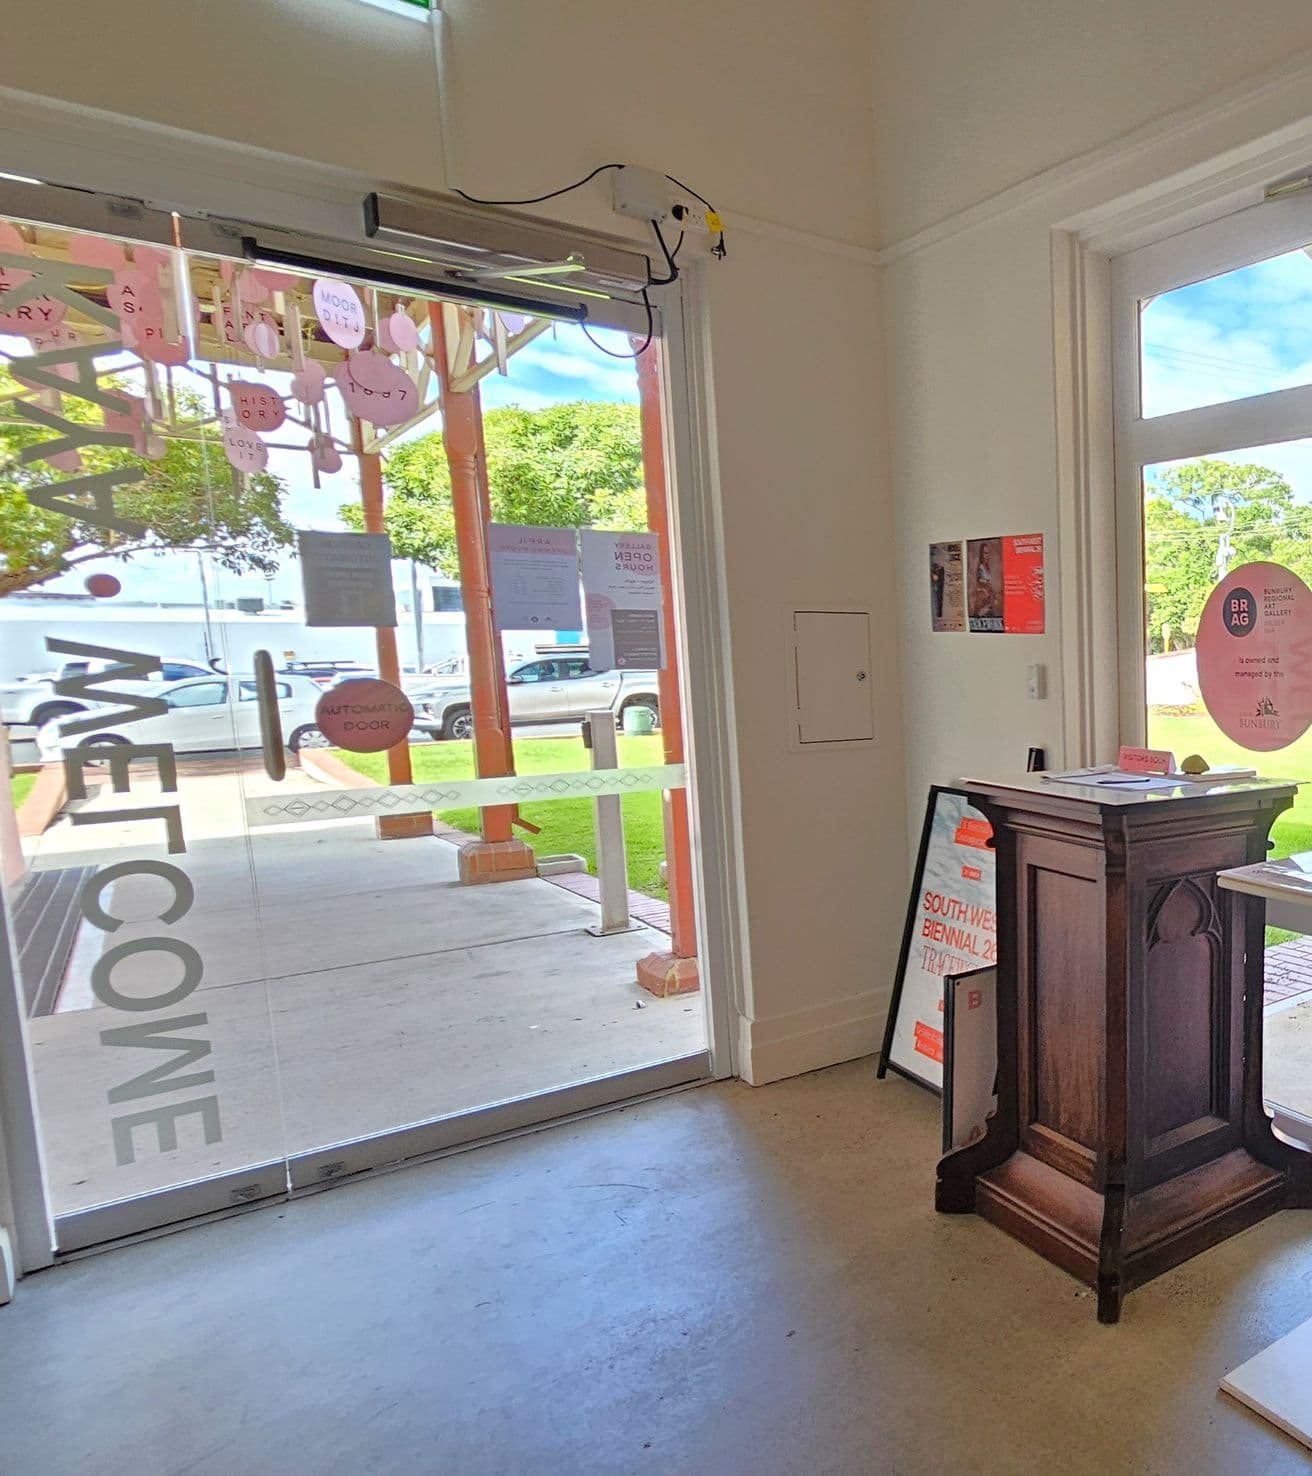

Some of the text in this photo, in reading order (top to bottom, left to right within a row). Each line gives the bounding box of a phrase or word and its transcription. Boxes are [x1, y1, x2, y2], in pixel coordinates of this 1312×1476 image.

[321, 289, 357, 313] MOOR
[240, 396, 277, 405] HIST
[242, 409, 279, 419] ORY
[229, 438, 262, 452] LOVE
[1231, 599, 1248, 611] BR
[1263, 609, 1292, 617] GALLERY
[1231, 613, 1249, 626] AG
[319, 703, 409, 717] AUTOMATIC
[344, 720, 390, 731] DOOR
[1239, 718, 1280, 730] BUNBURY
[923, 891, 996, 933] SOUTH WES
[922, 917, 979, 956] BIENNIAL
